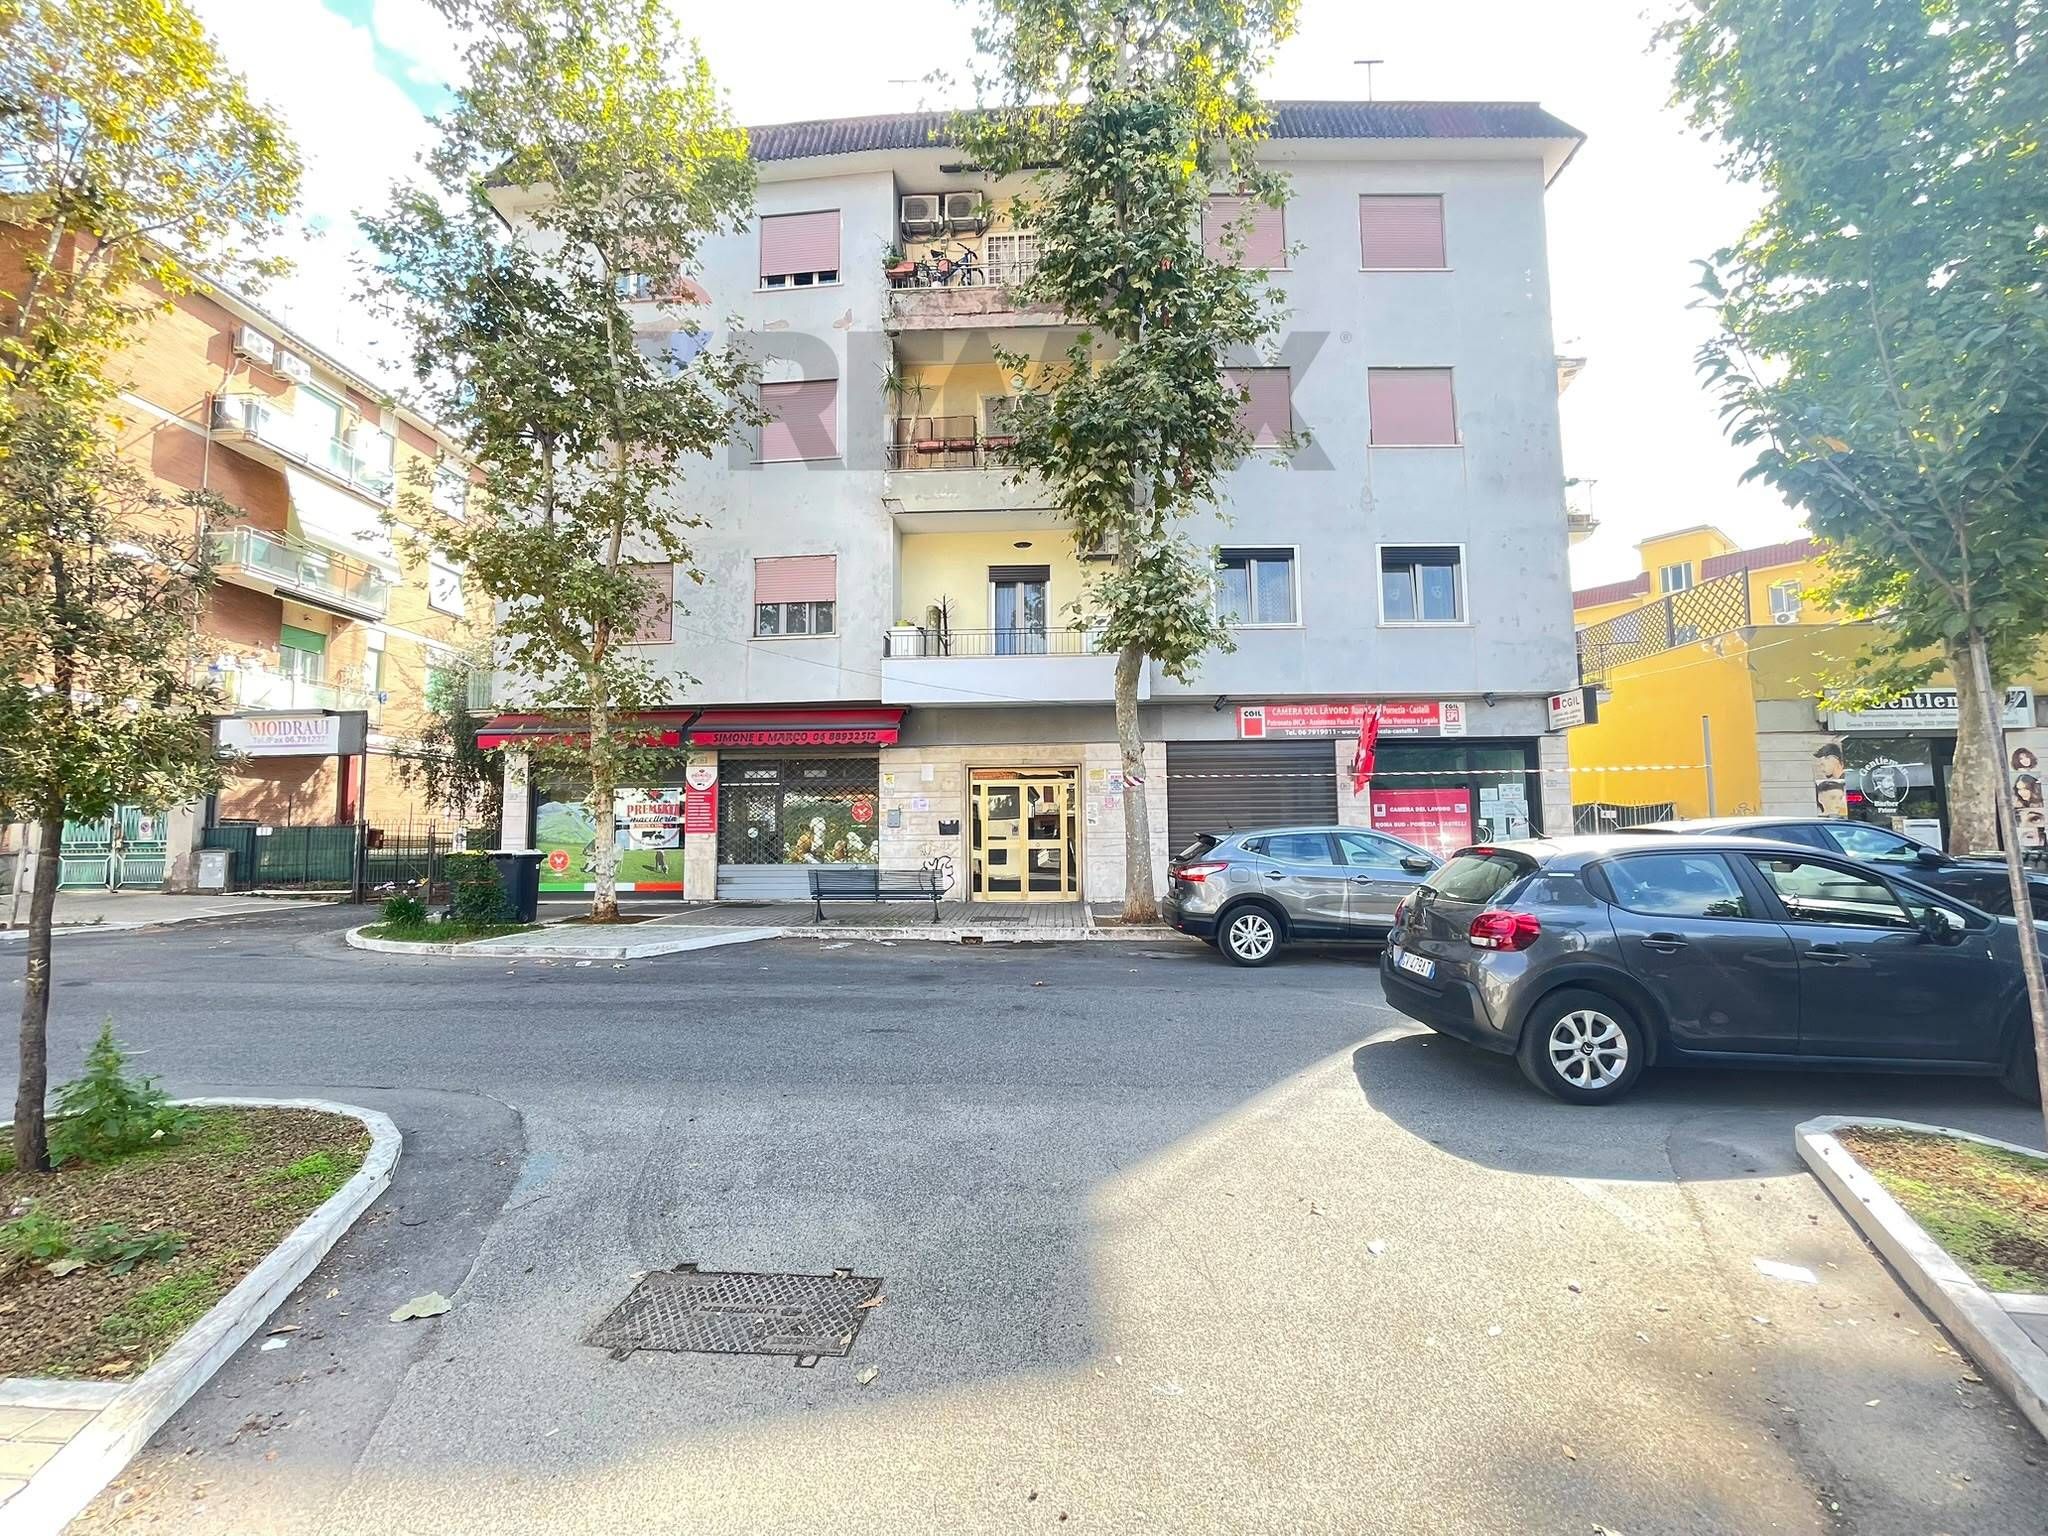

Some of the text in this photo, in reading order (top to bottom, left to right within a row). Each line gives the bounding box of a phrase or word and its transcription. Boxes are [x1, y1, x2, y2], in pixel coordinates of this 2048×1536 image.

[1562, 697, 1580, 708] CGIL
[1272, 706, 1303, 716] CAMERA
[1304, 706, 1319, 715] DEL
[1320, 705, 1349, 715] LAVORO
[1409, 703, 1430, 714] Castelli
[713, 732, 754, 743] SIMONE
[758, 732, 764, 742] E
[767, 732, 808, 742] MARCO
[812, 732, 826, 741] 06
